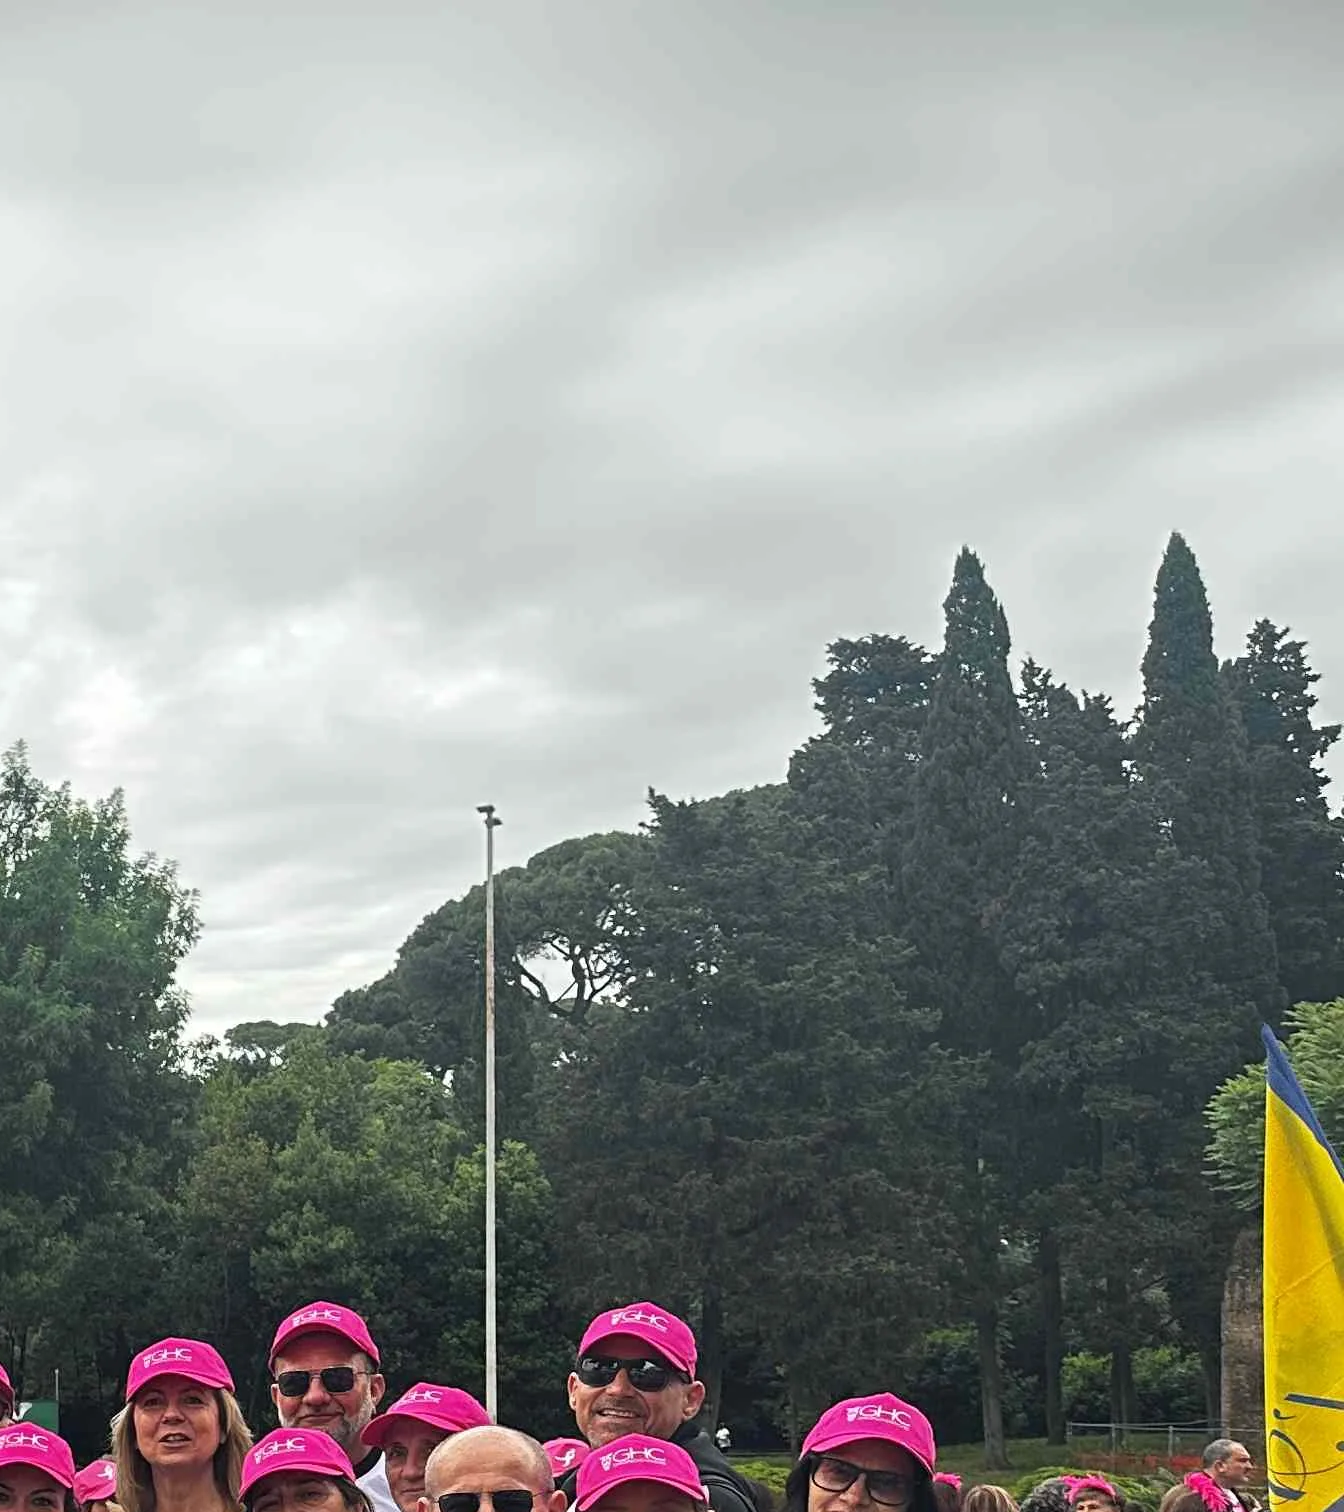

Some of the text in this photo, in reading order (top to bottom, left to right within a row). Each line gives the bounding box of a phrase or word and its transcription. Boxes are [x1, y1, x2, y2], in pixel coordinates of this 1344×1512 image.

[302, 1309, 341, 1321] GHC
[621, 1310, 670, 1328] GHC
[153, 1347, 192, 1360] GHC
[860, 1404, 912, 1427] GHC
[6, 1432, 49, 1447] GHC
[263, 1437, 305, 1452] GHC
[614, 1447, 666, 1463] GHC
